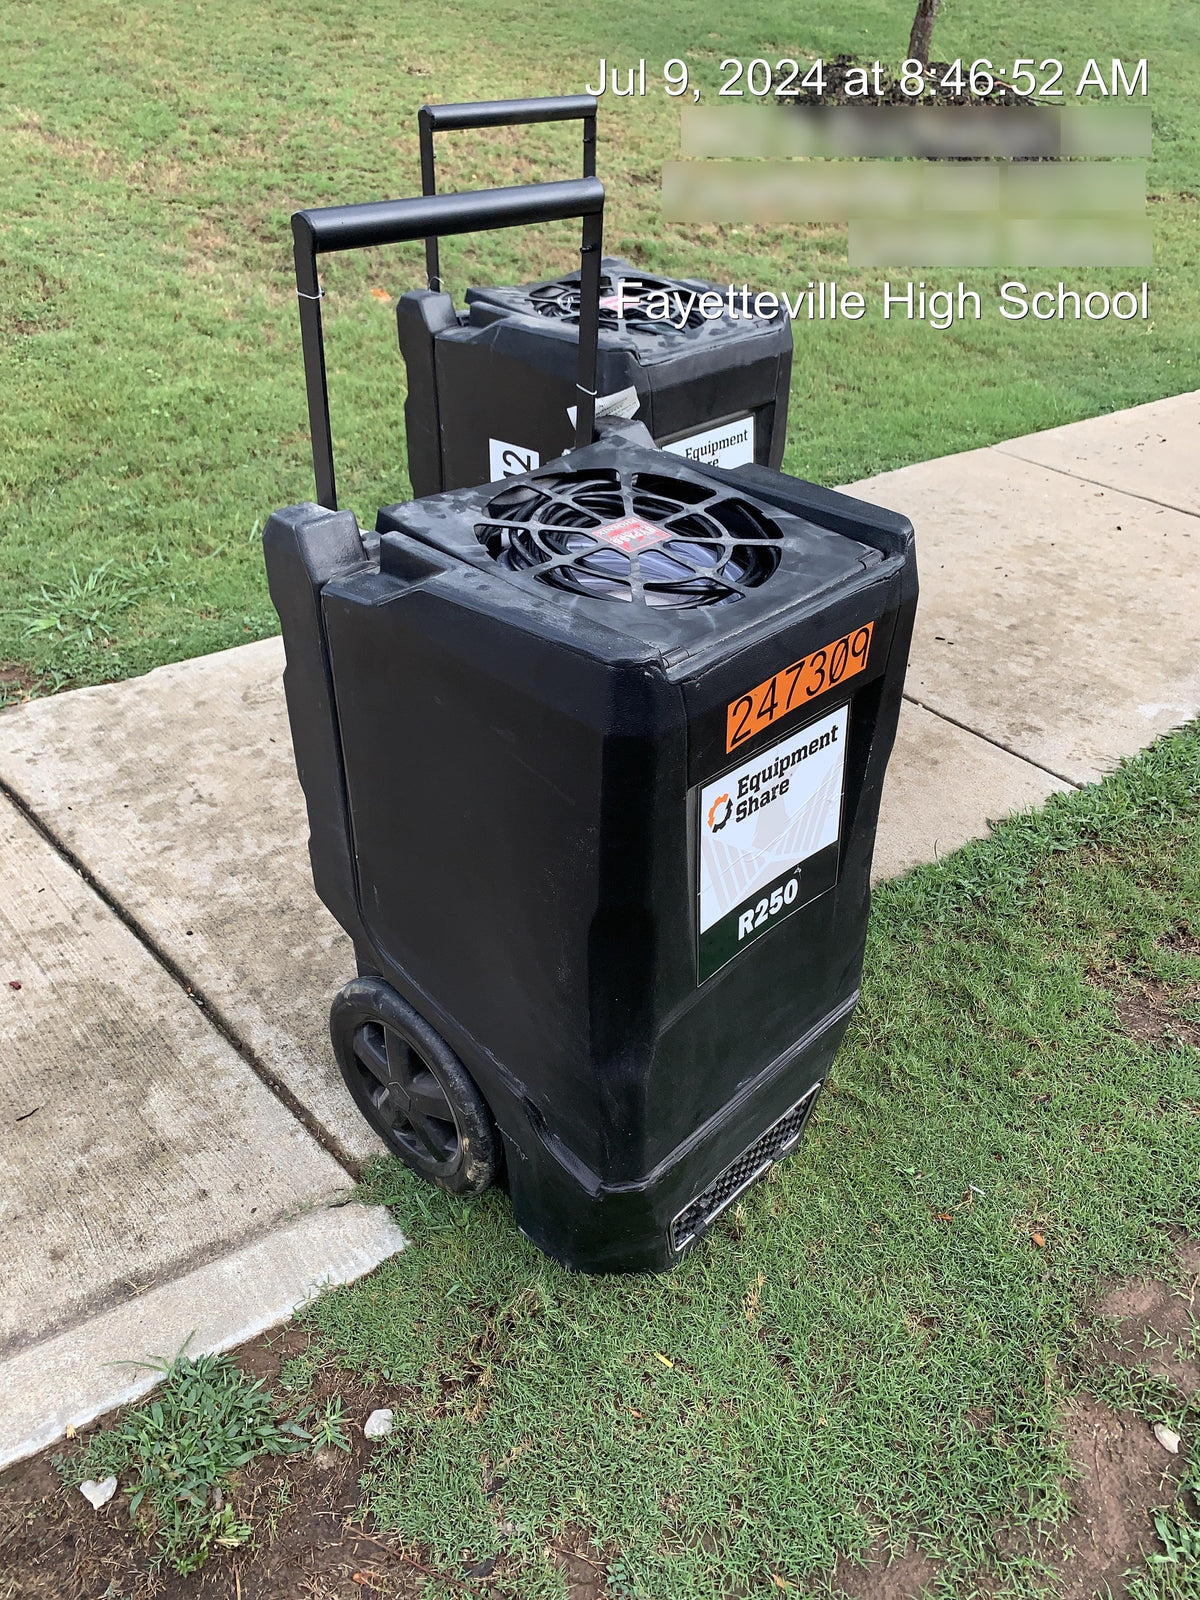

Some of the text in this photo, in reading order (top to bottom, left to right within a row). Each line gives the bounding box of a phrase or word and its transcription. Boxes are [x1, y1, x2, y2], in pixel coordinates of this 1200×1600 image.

[685, 429, 748, 461] Equipment
[730, 626, 869, 748] 247309
[736, 725, 839, 800] Equipment
[735, 777, 791, 823] Share
[737, 878, 799, 941] R250
